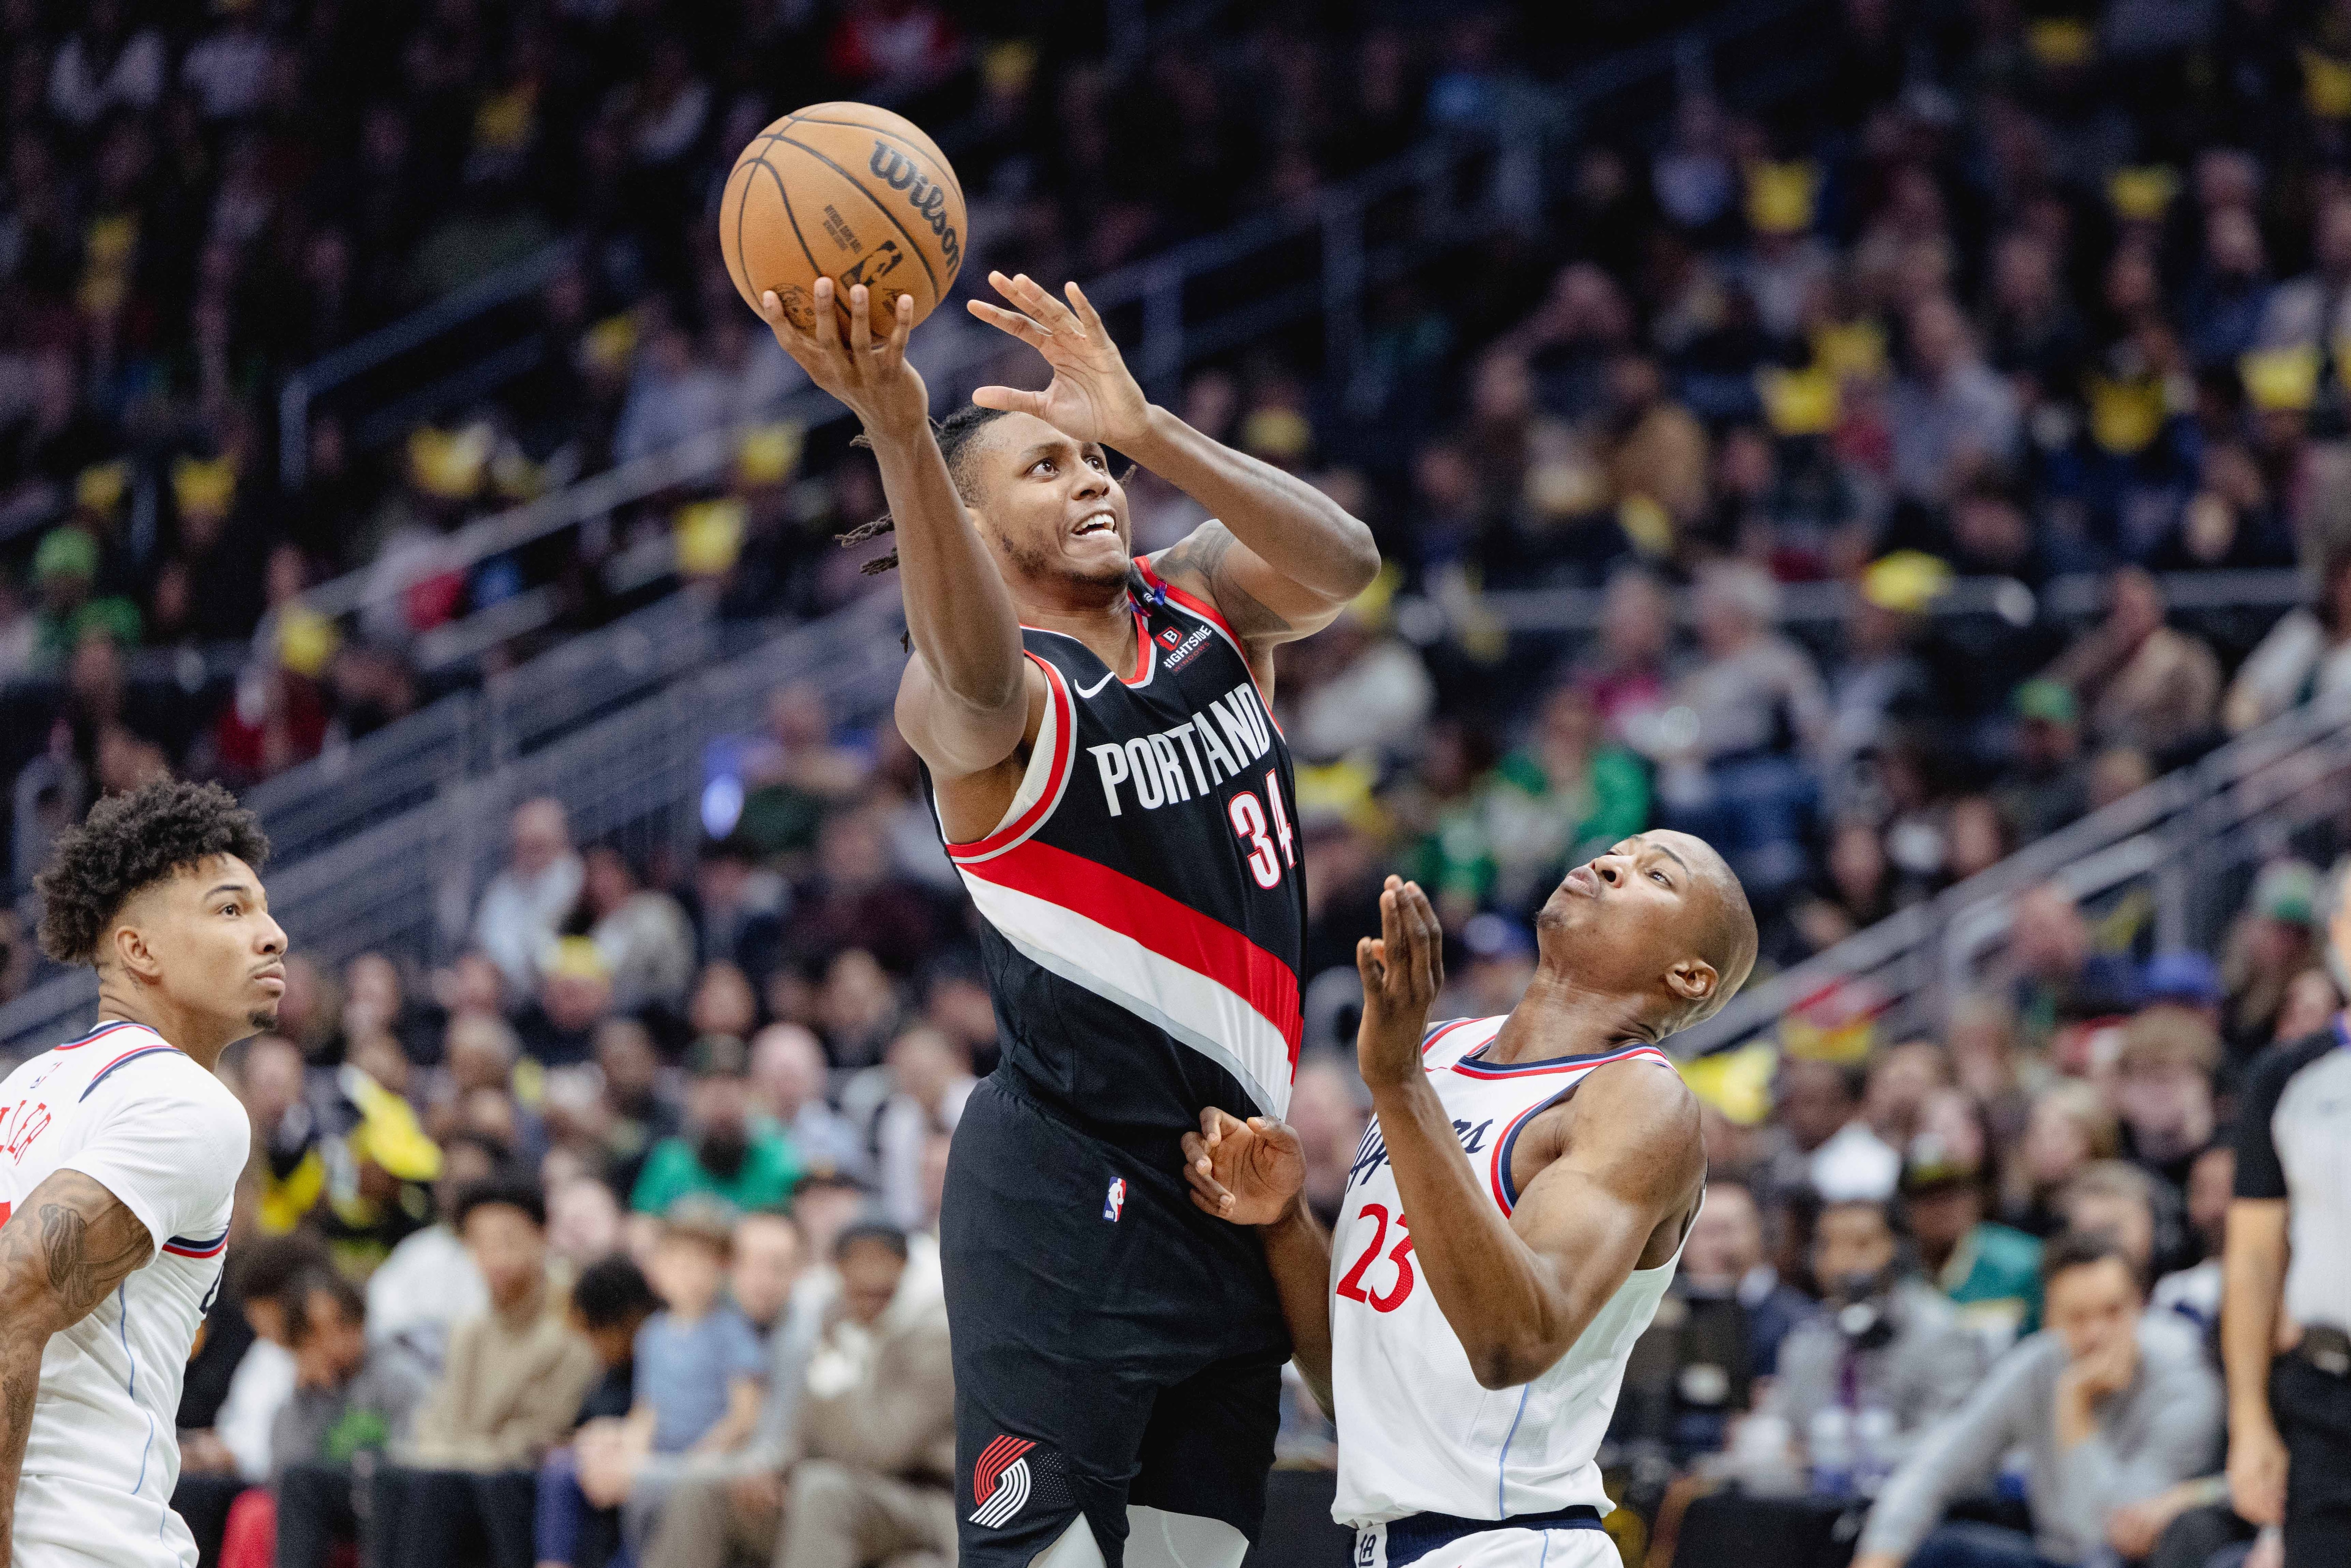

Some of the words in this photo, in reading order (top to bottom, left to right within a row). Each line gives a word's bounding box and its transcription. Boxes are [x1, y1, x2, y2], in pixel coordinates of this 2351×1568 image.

[868, 139, 960, 277] Wilson
[1174, 642, 1210, 671] WINDOWS
[1228, 768, 1296, 889] 34
[1104, 1210, 1114, 1219] NBA
[1336, 1203, 1414, 1313] 23
